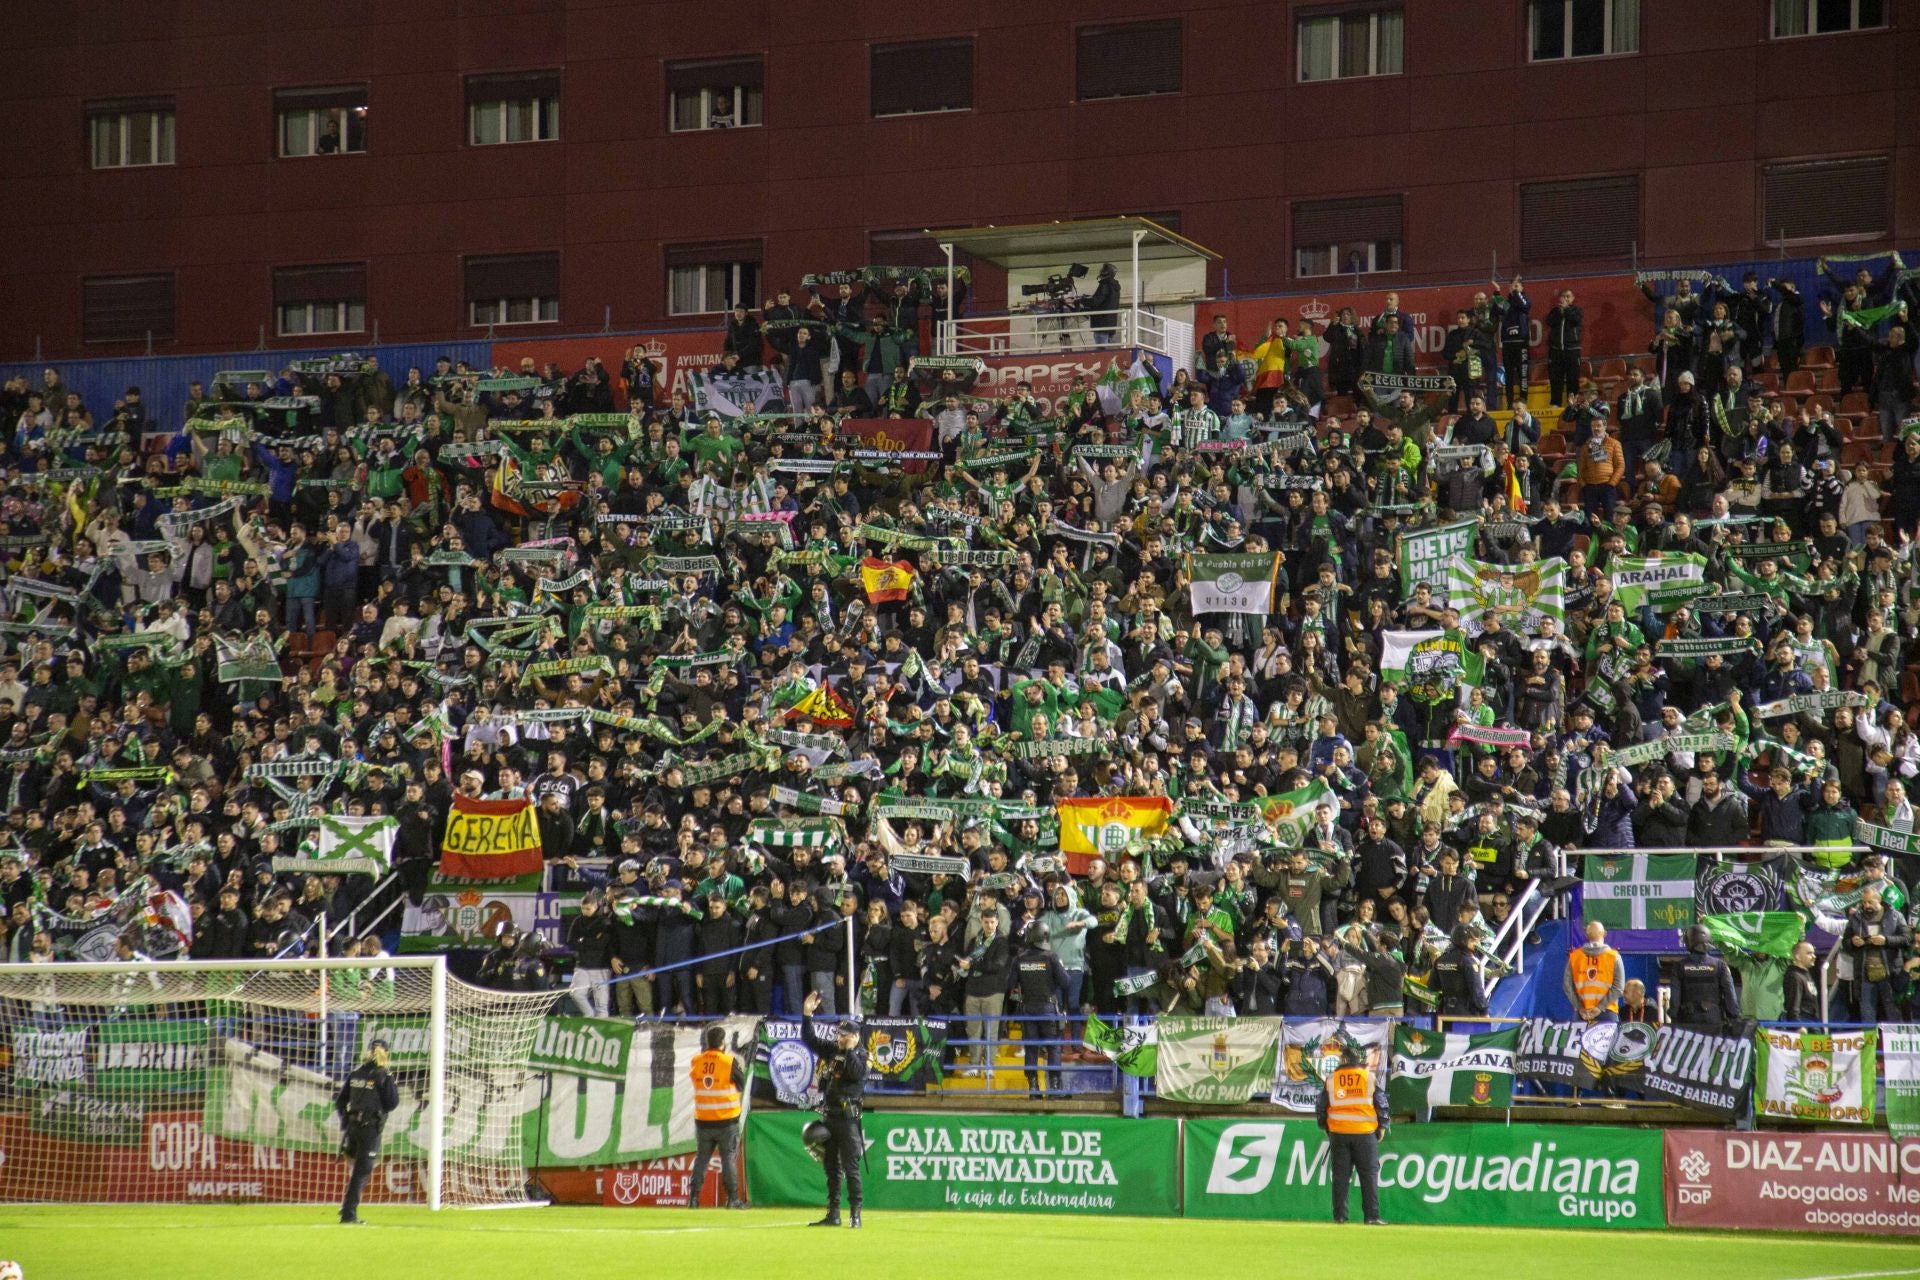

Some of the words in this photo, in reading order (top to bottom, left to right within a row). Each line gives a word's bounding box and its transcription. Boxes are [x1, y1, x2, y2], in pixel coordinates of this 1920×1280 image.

[677, 354, 722, 367] AYUNTAM
[995, 384, 1096, 395] INSLACIOES
[1409, 530, 1469, 562] BETIS
[1619, 566, 1690, 586] ARAHAL
[1205, 597, 1248, 607] 41130
[1417, 640, 1461, 653] ALMON
[1789, 694, 1818, 710] REAL
[448, 813, 537, 853] GERENA
[1881, 830, 1908, 851] Real
[1612, 884, 1639, 897] CREO
[1640, 884, 1652, 897] EN
[1653, 884, 1662, 897] TI
[1414, 1052, 1515, 1075] CAMPANA
[1645, 1024, 1751, 1090] QUINTO
[702, 1062, 715, 1075] 30
[1532, 1060, 1547, 1074] DE
[1550, 1061, 1574, 1077] TUS
[1339, 1074, 1361, 1087] 057
[1645, 1074, 1684, 1097] TRECE
[1684, 1085, 1736, 1109] BARRAS
[1757, 1099, 1871, 1121] VALDEMORO
[151, 1122, 217, 1171] COPA
[886, 1128, 954, 1155] CAJA
[960, 1129, 1055, 1155] RURAL
[1061, 1131, 1101, 1156] DE
[886, 1155, 1119, 1185] EXTREMADURA
[1285, 1139, 1641, 1203] Mcoguadiana
[187, 1182, 263, 1196] MAPFRE
[641, 1175, 671, 1195] COPA
[1759, 1181, 1868, 1205] Abogados
[945, 1185, 961, 1205] la
[964, 1192, 994, 1209] caja
[998, 1189, 1016, 1206] de
[1021, 1188, 1116, 1210] Extremadura
[1678, 1189, 1712, 1205] DaP
[1558, 1194, 1637, 1222] Grupo
